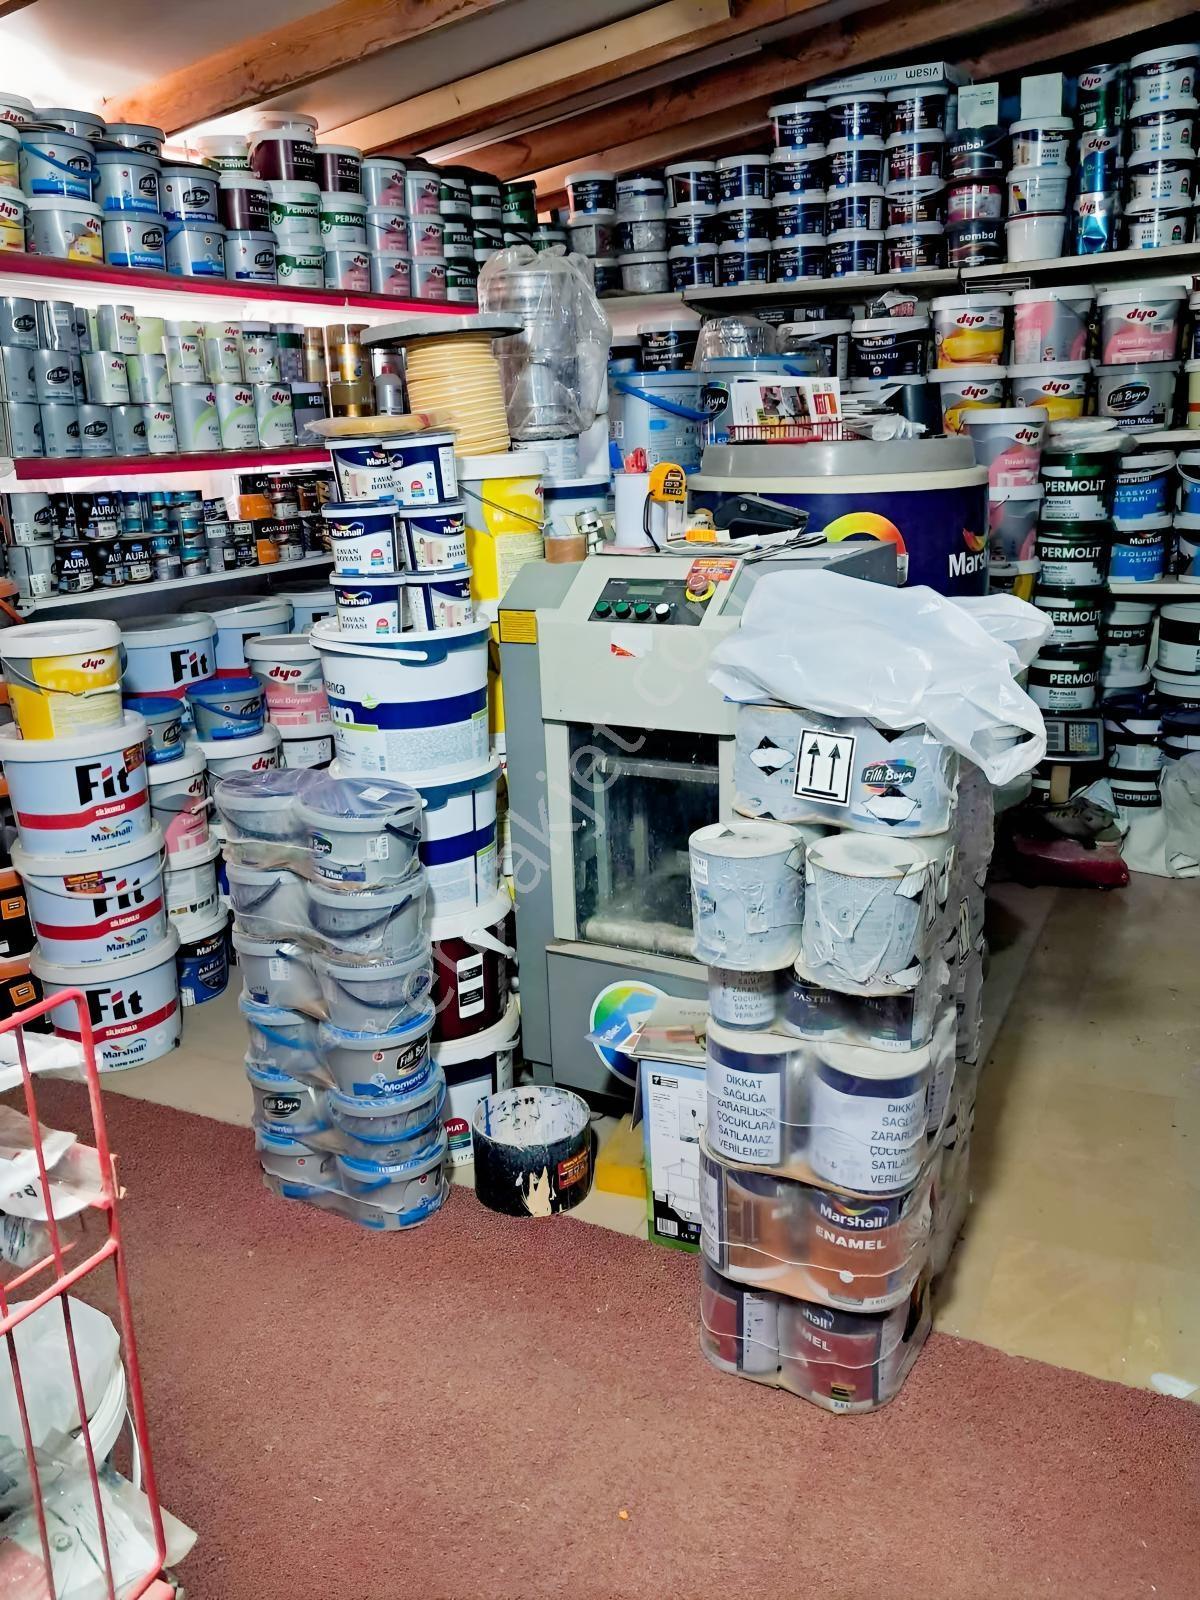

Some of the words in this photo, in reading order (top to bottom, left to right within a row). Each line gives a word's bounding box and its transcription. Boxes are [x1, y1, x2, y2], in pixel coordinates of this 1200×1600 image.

[1081, 75, 1102, 90] dyo
[1088, 139, 1111, 150] dyo
[956, 313, 985, 329] dyo
[1126, 308, 1158, 324] dyo
[961, 386, 989, 399] dyo
[1042, 380, 1071, 396] dyo
[234, 391, 253, 404] dyo
[271, 391, 290, 404] dyo
[1125, 389, 1148, 404] Boya
[154, 412, 171, 422] dyo
[1015, 428, 1040, 445] dyo
[91, 507, 115, 517] AURA
[331, 526, 364, 538] Marshall
[125, 551, 149, 561] AURA
[64, 559, 90, 570] AURA
[338, 596, 372, 606] Marshall
[81, 658, 106, 670] dyo
[170, 649, 209, 685] Fit
[269, 666, 302, 682] dyo
[251, 756, 277, 771] dyo
[863, 769, 883, 782] Filli
[884, 769, 914, 782] Boya
[75, 762, 134, 808] Fit
[91, 825, 133, 843] Marshall
[326, 868, 344, 881] Max
[92, 874, 145, 919] Fit
[106, 933, 148, 953] Marshall
[84, 988, 144, 1028] Fit
[102, 1043, 147, 1060] Marshall
[399, 1051, 415, 1068] Filli
[383, 1073, 426, 1094] Momento
[726, 1073, 763, 1090] DIKKAT
[276, 1099, 301, 1112] Boya
[446, 1123, 466, 1134] MAT
[819, 1202, 888, 1229] Marshall
[814, 1224, 887, 1251] ENAMEL
